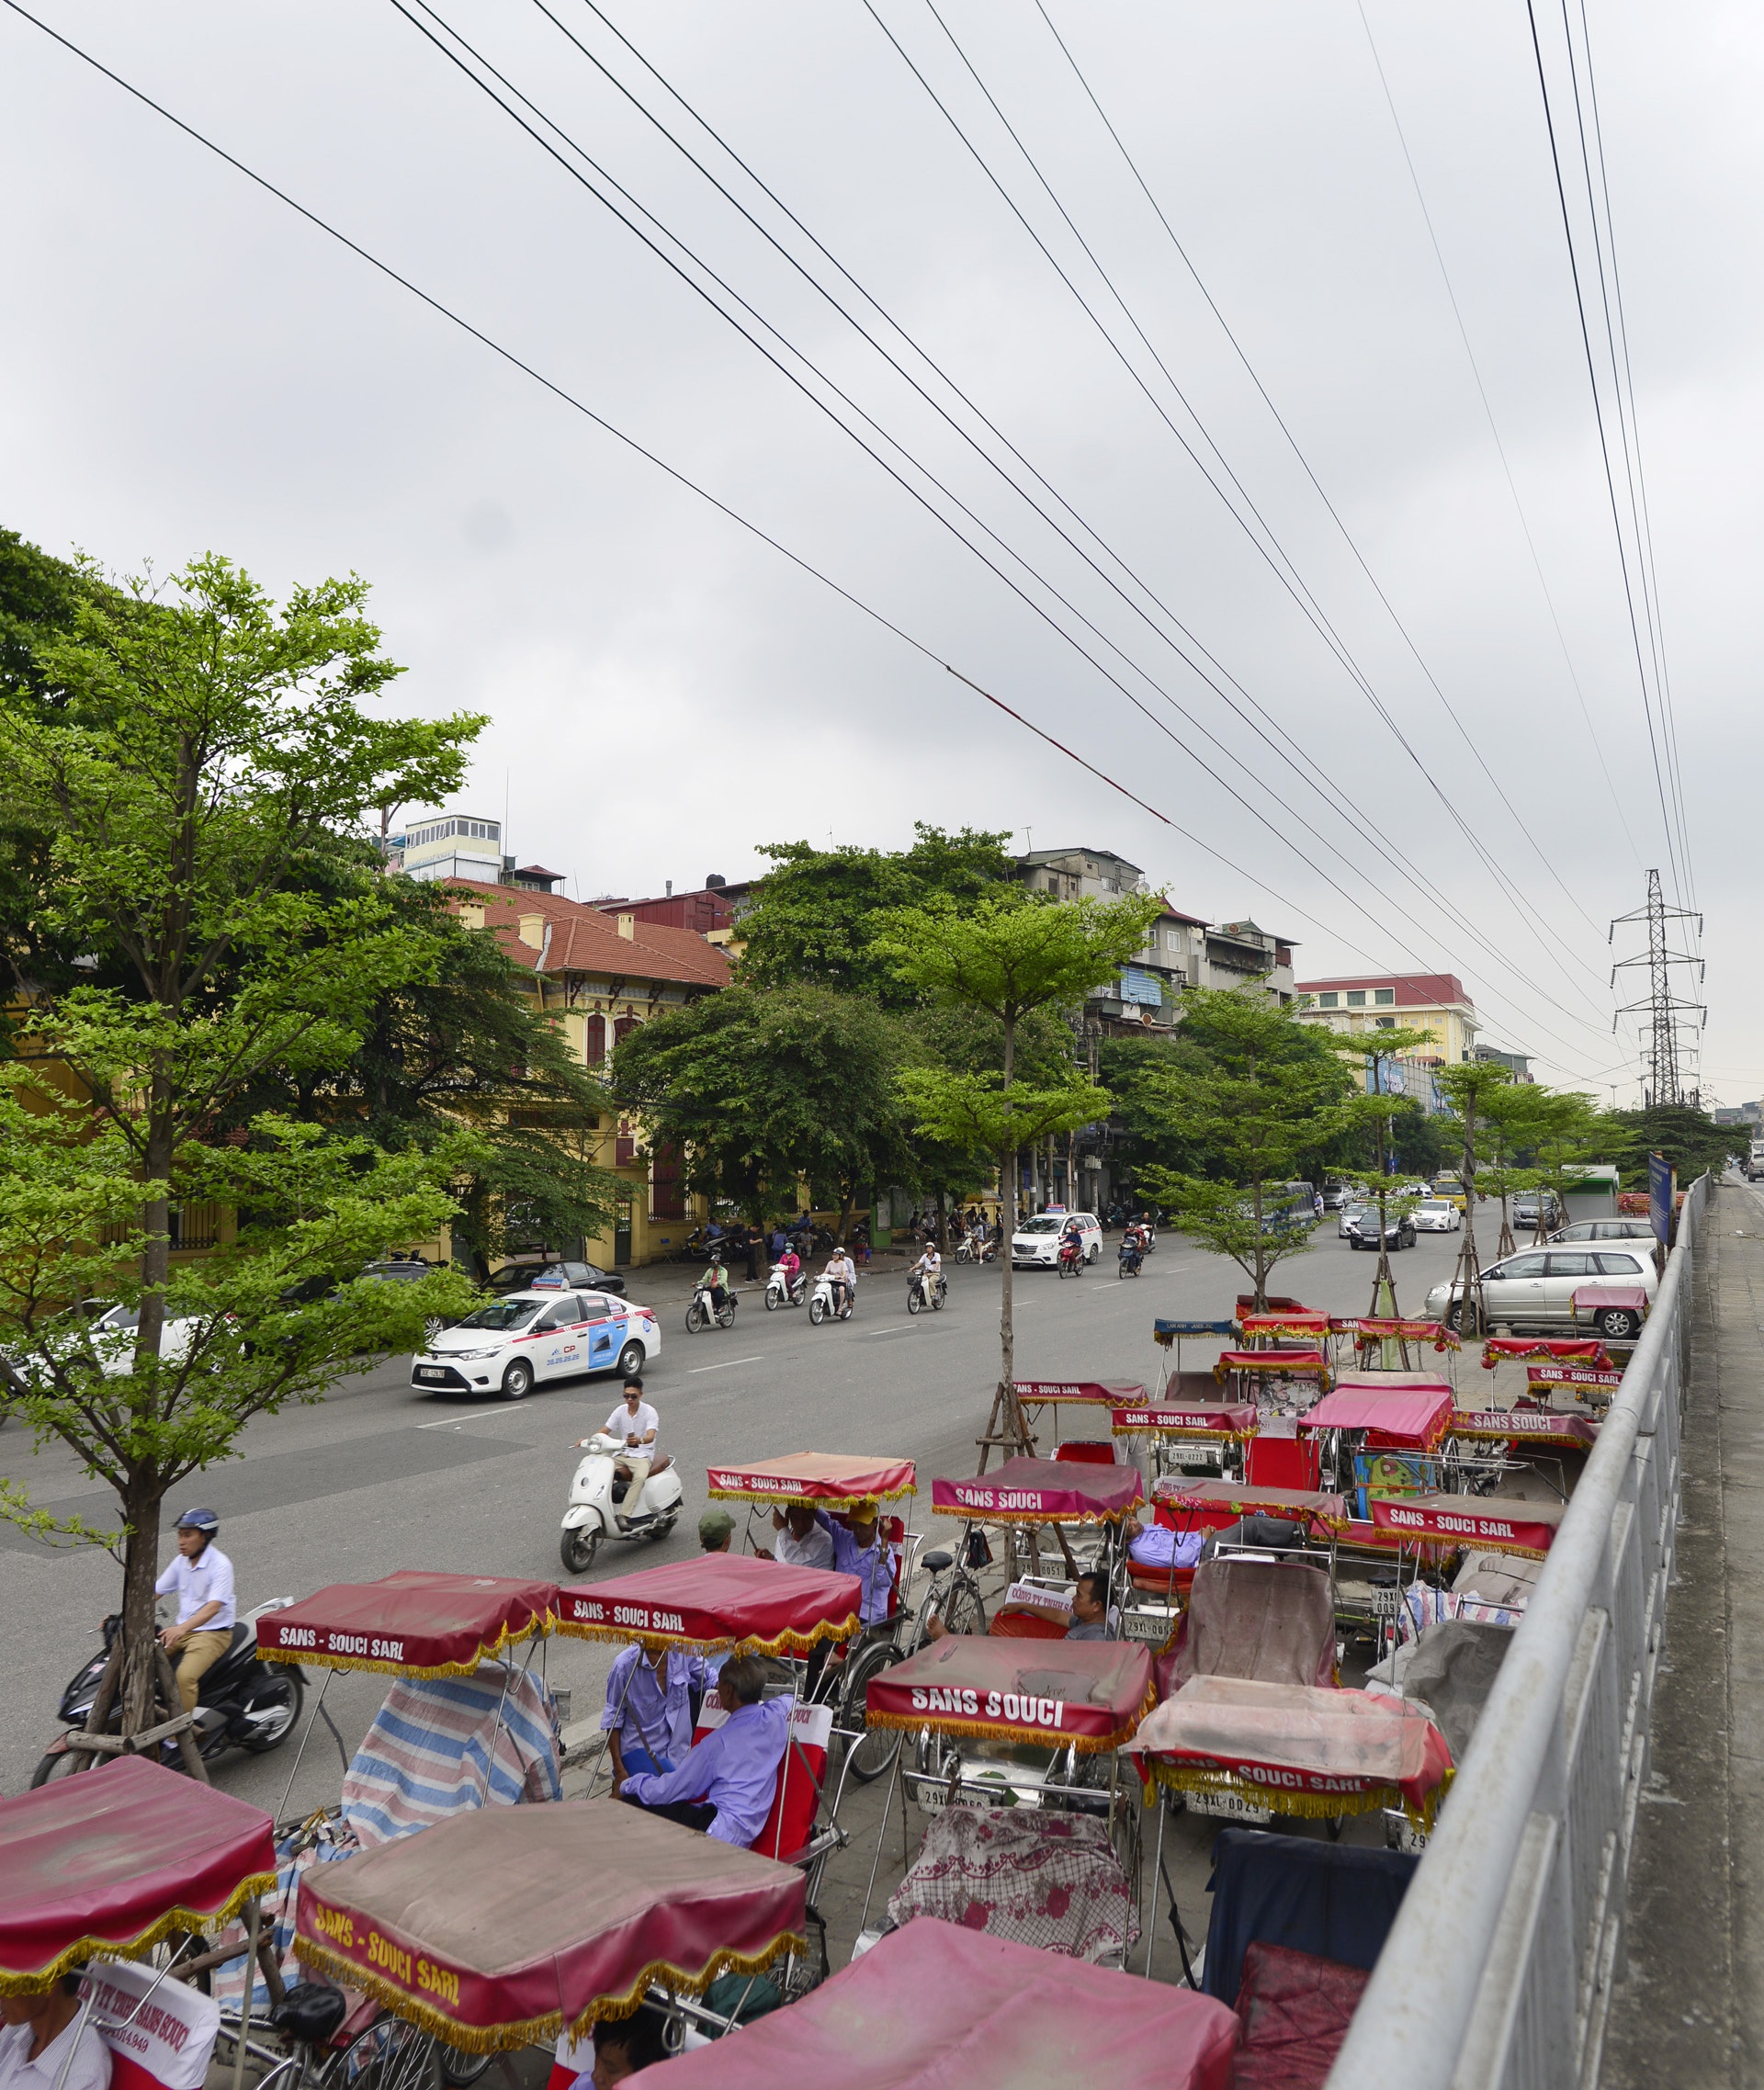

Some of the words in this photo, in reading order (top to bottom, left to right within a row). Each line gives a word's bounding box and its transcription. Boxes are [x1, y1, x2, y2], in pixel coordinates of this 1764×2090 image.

[564, 1345, 575, 1353] CP
[1541, 1369, 1563, 1379] SANS
[1571, 1372, 1596, 1382] SOUCI
[1598, 1374, 1621, 1385] SARL
[1038, 1384, 1060, 1394] SOUCI
[1062, 1386, 1080, 1395] SARL
[1126, 1413, 1148, 1424] SANS
[1157, 1415, 1183, 1426] SOUCI
[1185, 1417, 1208, 1427] SARL
[1474, 1415, 1509, 1429] SANS
[1512, 1416, 1551, 1430] SOUCI
[719, 1474, 743, 1486] SANS
[752, 1476, 778, 1489] SOUCI
[781, 1479, 803, 1492] SARL
[956, 1487, 993, 1508] SANS
[999, 1491, 1042, 1509] SOUCI
[1390, 1508, 1424, 1526] SANS
[1437, 1516, 1476, 1533] SOUCI
[1480, 1521, 1514, 1538] SARL
[1032, 1594, 1044, 1606] TY
[573, 1599, 604, 1620] SANS
[614, 1606, 648, 1627] SOUCI
[652, 1611, 684, 1632] SARL
[279, 1627, 316, 1646] SANS
[328, 1633, 368, 1655] SOUCI
[371, 1639, 404, 1661] SARL
[911, 1688, 978, 1715] SANS
[986, 1690, 1064, 1727] SOUCI
[1161, 1753, 1219, 1768] SANS
[1238, 1765, 1303, 1788] SOUCI
[1310, 1777, 1365, 1791] SARL
[1411, 1833, 1426, 1848] 29
[314, 1903, 354, 1948] SANS
[368, 1931, 412, 1984] SOUCI
[416, 1959, 459, 2007] SARL
[157, 2013, 191, 2056] SOUCI
